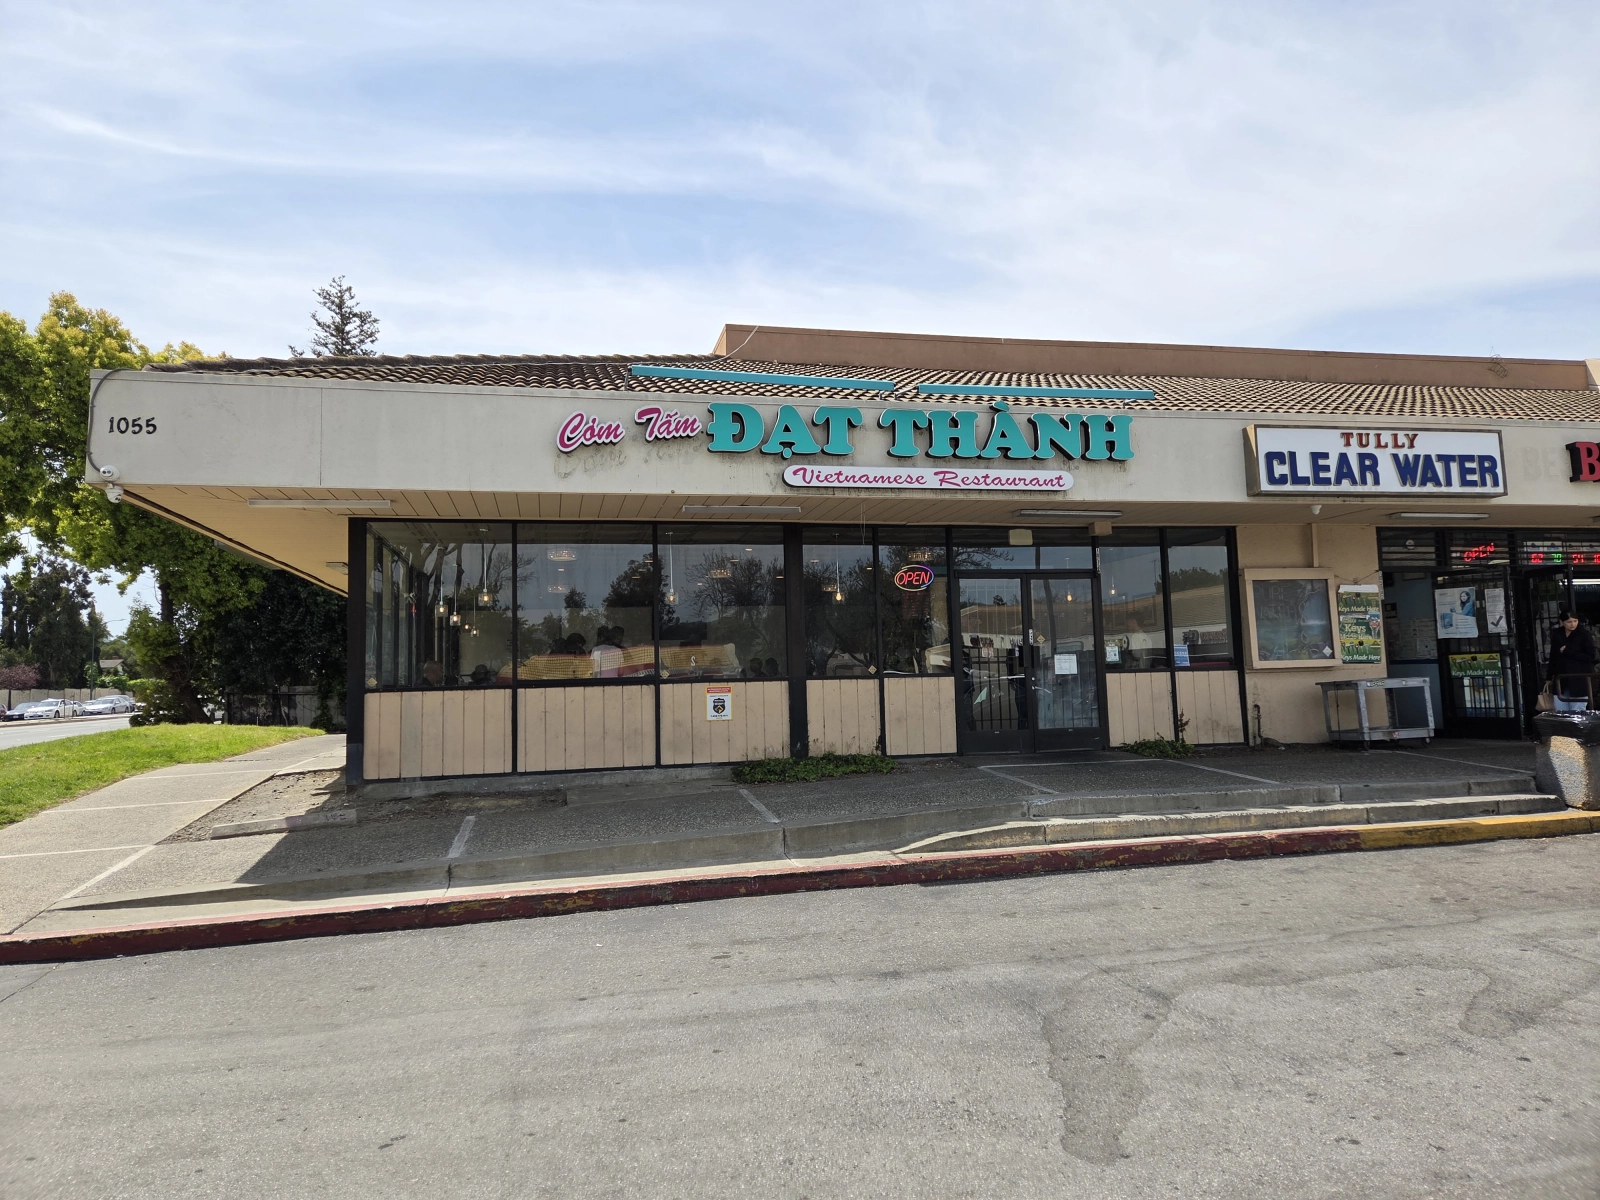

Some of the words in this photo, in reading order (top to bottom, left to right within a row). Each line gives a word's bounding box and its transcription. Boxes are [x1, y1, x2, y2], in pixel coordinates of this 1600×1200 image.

[108, 416, 157, 435] 1055
[706, 402, 863, 459] ĐẠT
[879, 400, 1135, 460] THÀNH
[1340, 432, 1419, 449] TULLY
[1264, 450, 1381, 487] CLEAR
[1390, 452, 1500, 488] WATER
[1570, 441, 1600, 482] B
[792, 466, 928, 486] Vietnamese
[933, 470, 1066, 488] Restaurant
[1463, 542, 1494, 561] OPEN
[896, 571, 931, 585] OPEN
[1345, 624, 1367, 634] Keys
